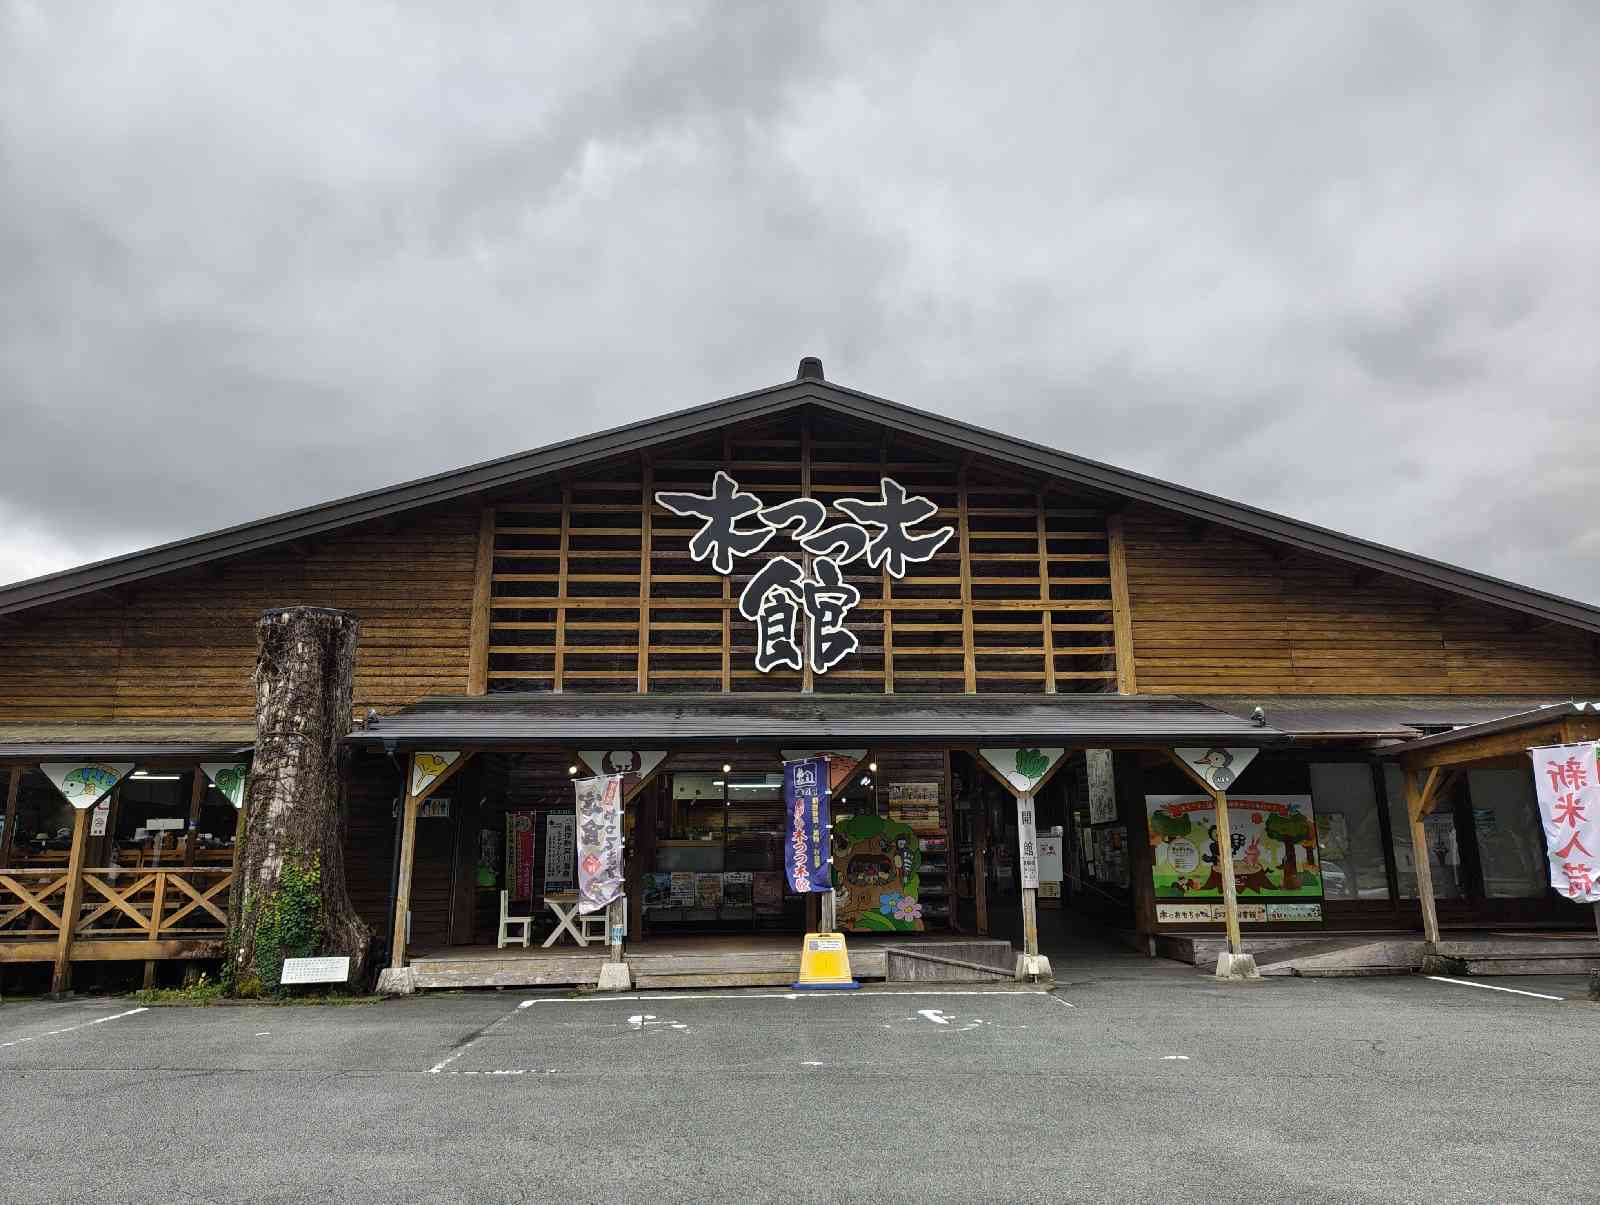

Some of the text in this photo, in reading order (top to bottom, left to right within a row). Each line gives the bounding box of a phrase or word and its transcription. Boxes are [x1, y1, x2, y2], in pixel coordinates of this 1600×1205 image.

[655, 470, 955, 579] 木つつ木
[738, 555, 861, 674] 館
